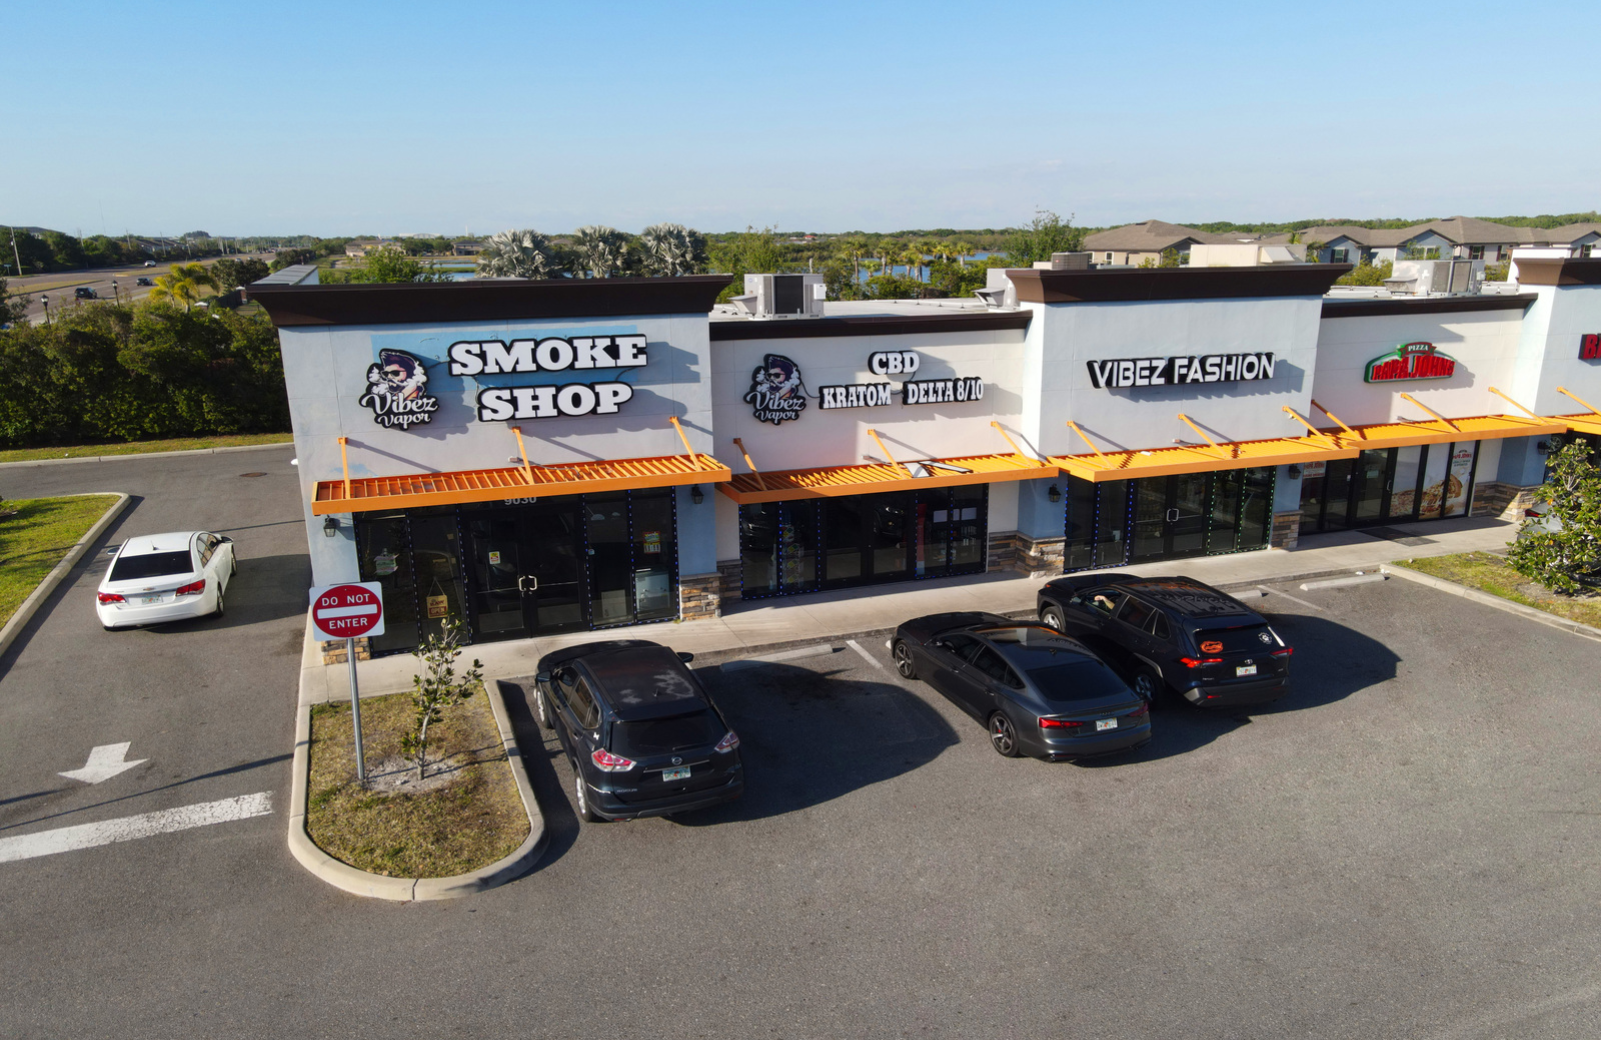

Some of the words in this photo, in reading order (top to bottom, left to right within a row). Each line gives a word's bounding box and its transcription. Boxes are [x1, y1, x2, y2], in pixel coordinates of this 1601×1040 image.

[450, 335, 647, 376] SMOKE
[1407, 344, 1429, 352] PIZZA
[871, 351, 920, 375] CBD
[1090, 358, 1166, 388] VIBEZ
[1171, 353, 1276, 385] FASHION
[1371, 356, 1410, 381] PAPA
[360, 392, 438, 415] Vibez
[479, 383, 633, 422] SHOP
[745, 391, 804, 411] Vibez
[821, 383, 892, 409] KRATOM
[904, 378, 955, 404] DELTA
[955, 377, 984, 402] 8/10
[504, 497, 537, 505] 9030
[321, 597, 338, 606] DO
[347, 594, 370, 604] NOT
[329, 617, 368, 629] ENTER
